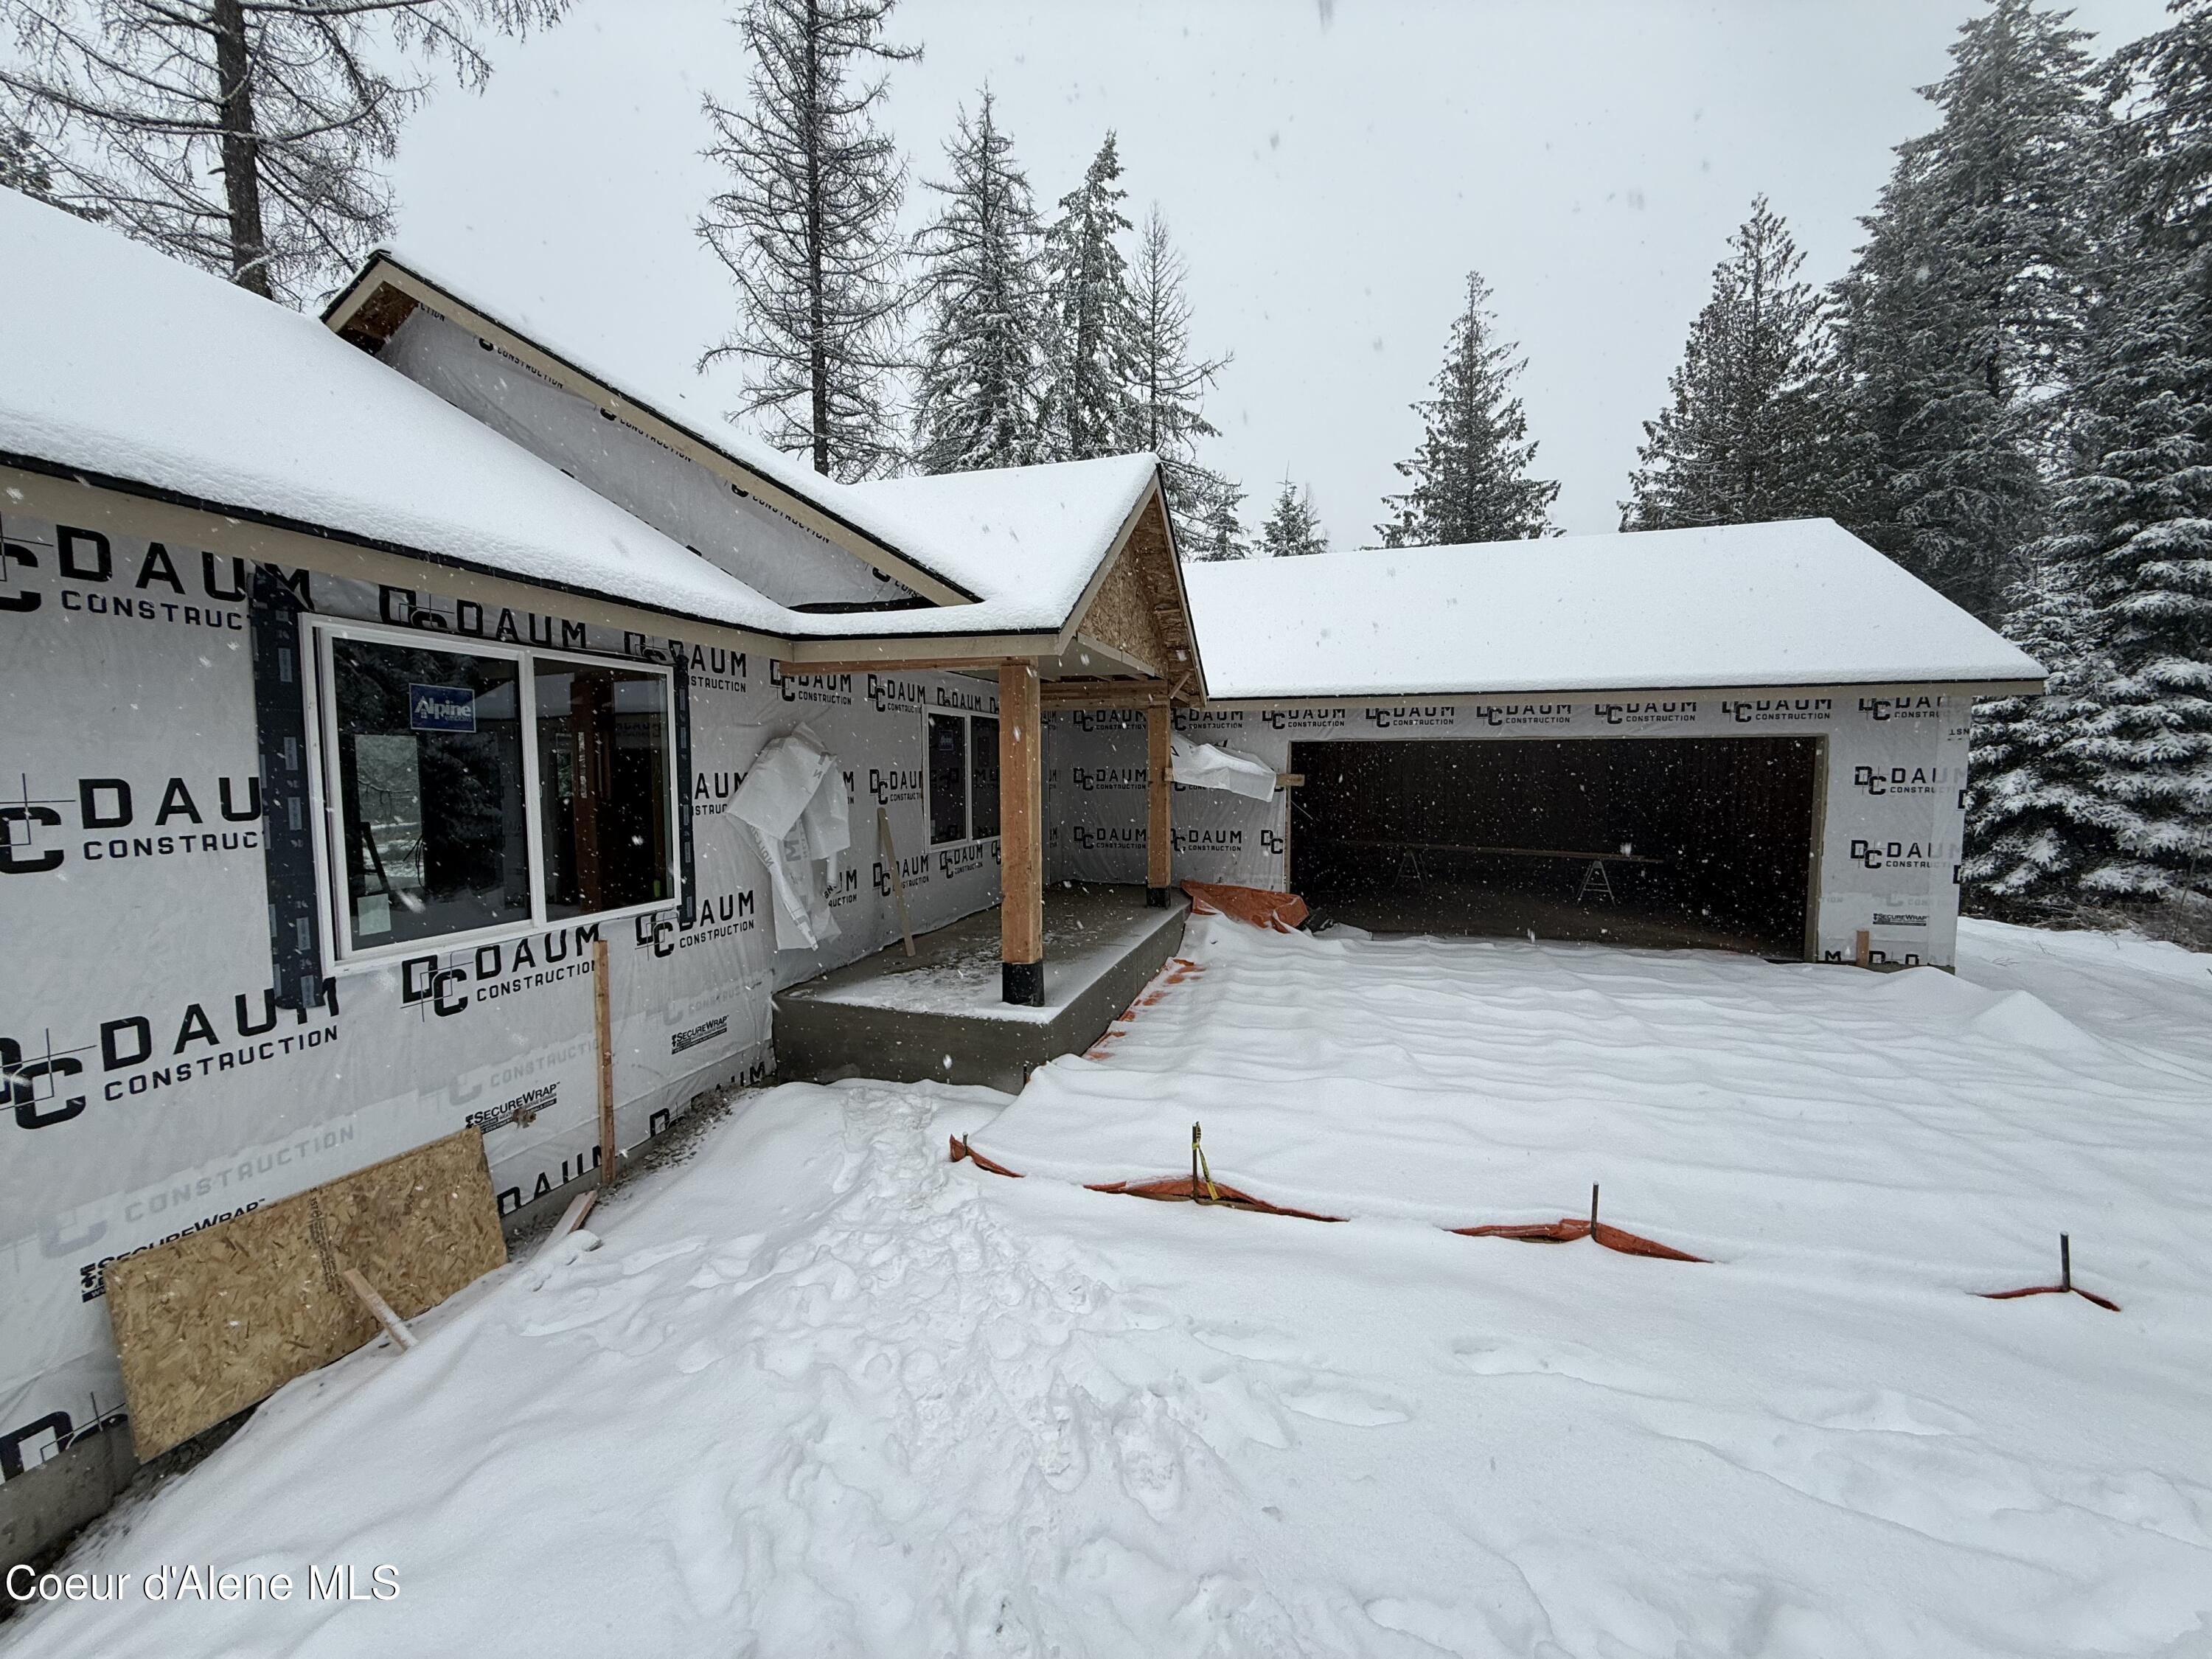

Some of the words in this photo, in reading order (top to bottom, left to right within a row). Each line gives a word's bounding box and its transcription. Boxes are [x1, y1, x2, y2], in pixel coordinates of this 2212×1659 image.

[61, 590, 251, 630] CONSTRUC
[457, 599, 587, 649] DAUM
[689, 675, 746, 693] STRUCTION
[887, 679, 926, 704] DAUM
[414, 696, 471, 720] Alpine
[799, 691, 852, 705] CONSTRUCTION
[952, 691, 981, 712] DAUM
[1189, 709, 1242, 721] DAUM
[1756, 712, 1830, 720] CONSTRUCTION
[890, 771, 921, 790] DAU
[1096, 769, 1147, 782] DAUM
[83, 831, 258, 860] CONSTRUC
[1096, 828, 1147, 841] DAUM
[1189, 830, 1242, 844] DAUM
[954, 844, 984, 865] DAUM
[680, 919, 754, 948] CONSTRUCTION
[476, 922, 600, 981] DAUM
[477, 960, 595, 1001] CONSTRUCTIO
[105, 1025, 338, 1101] CONSTRUCTION
[125, 1124, 355, 1223] CONSTRUCTION
